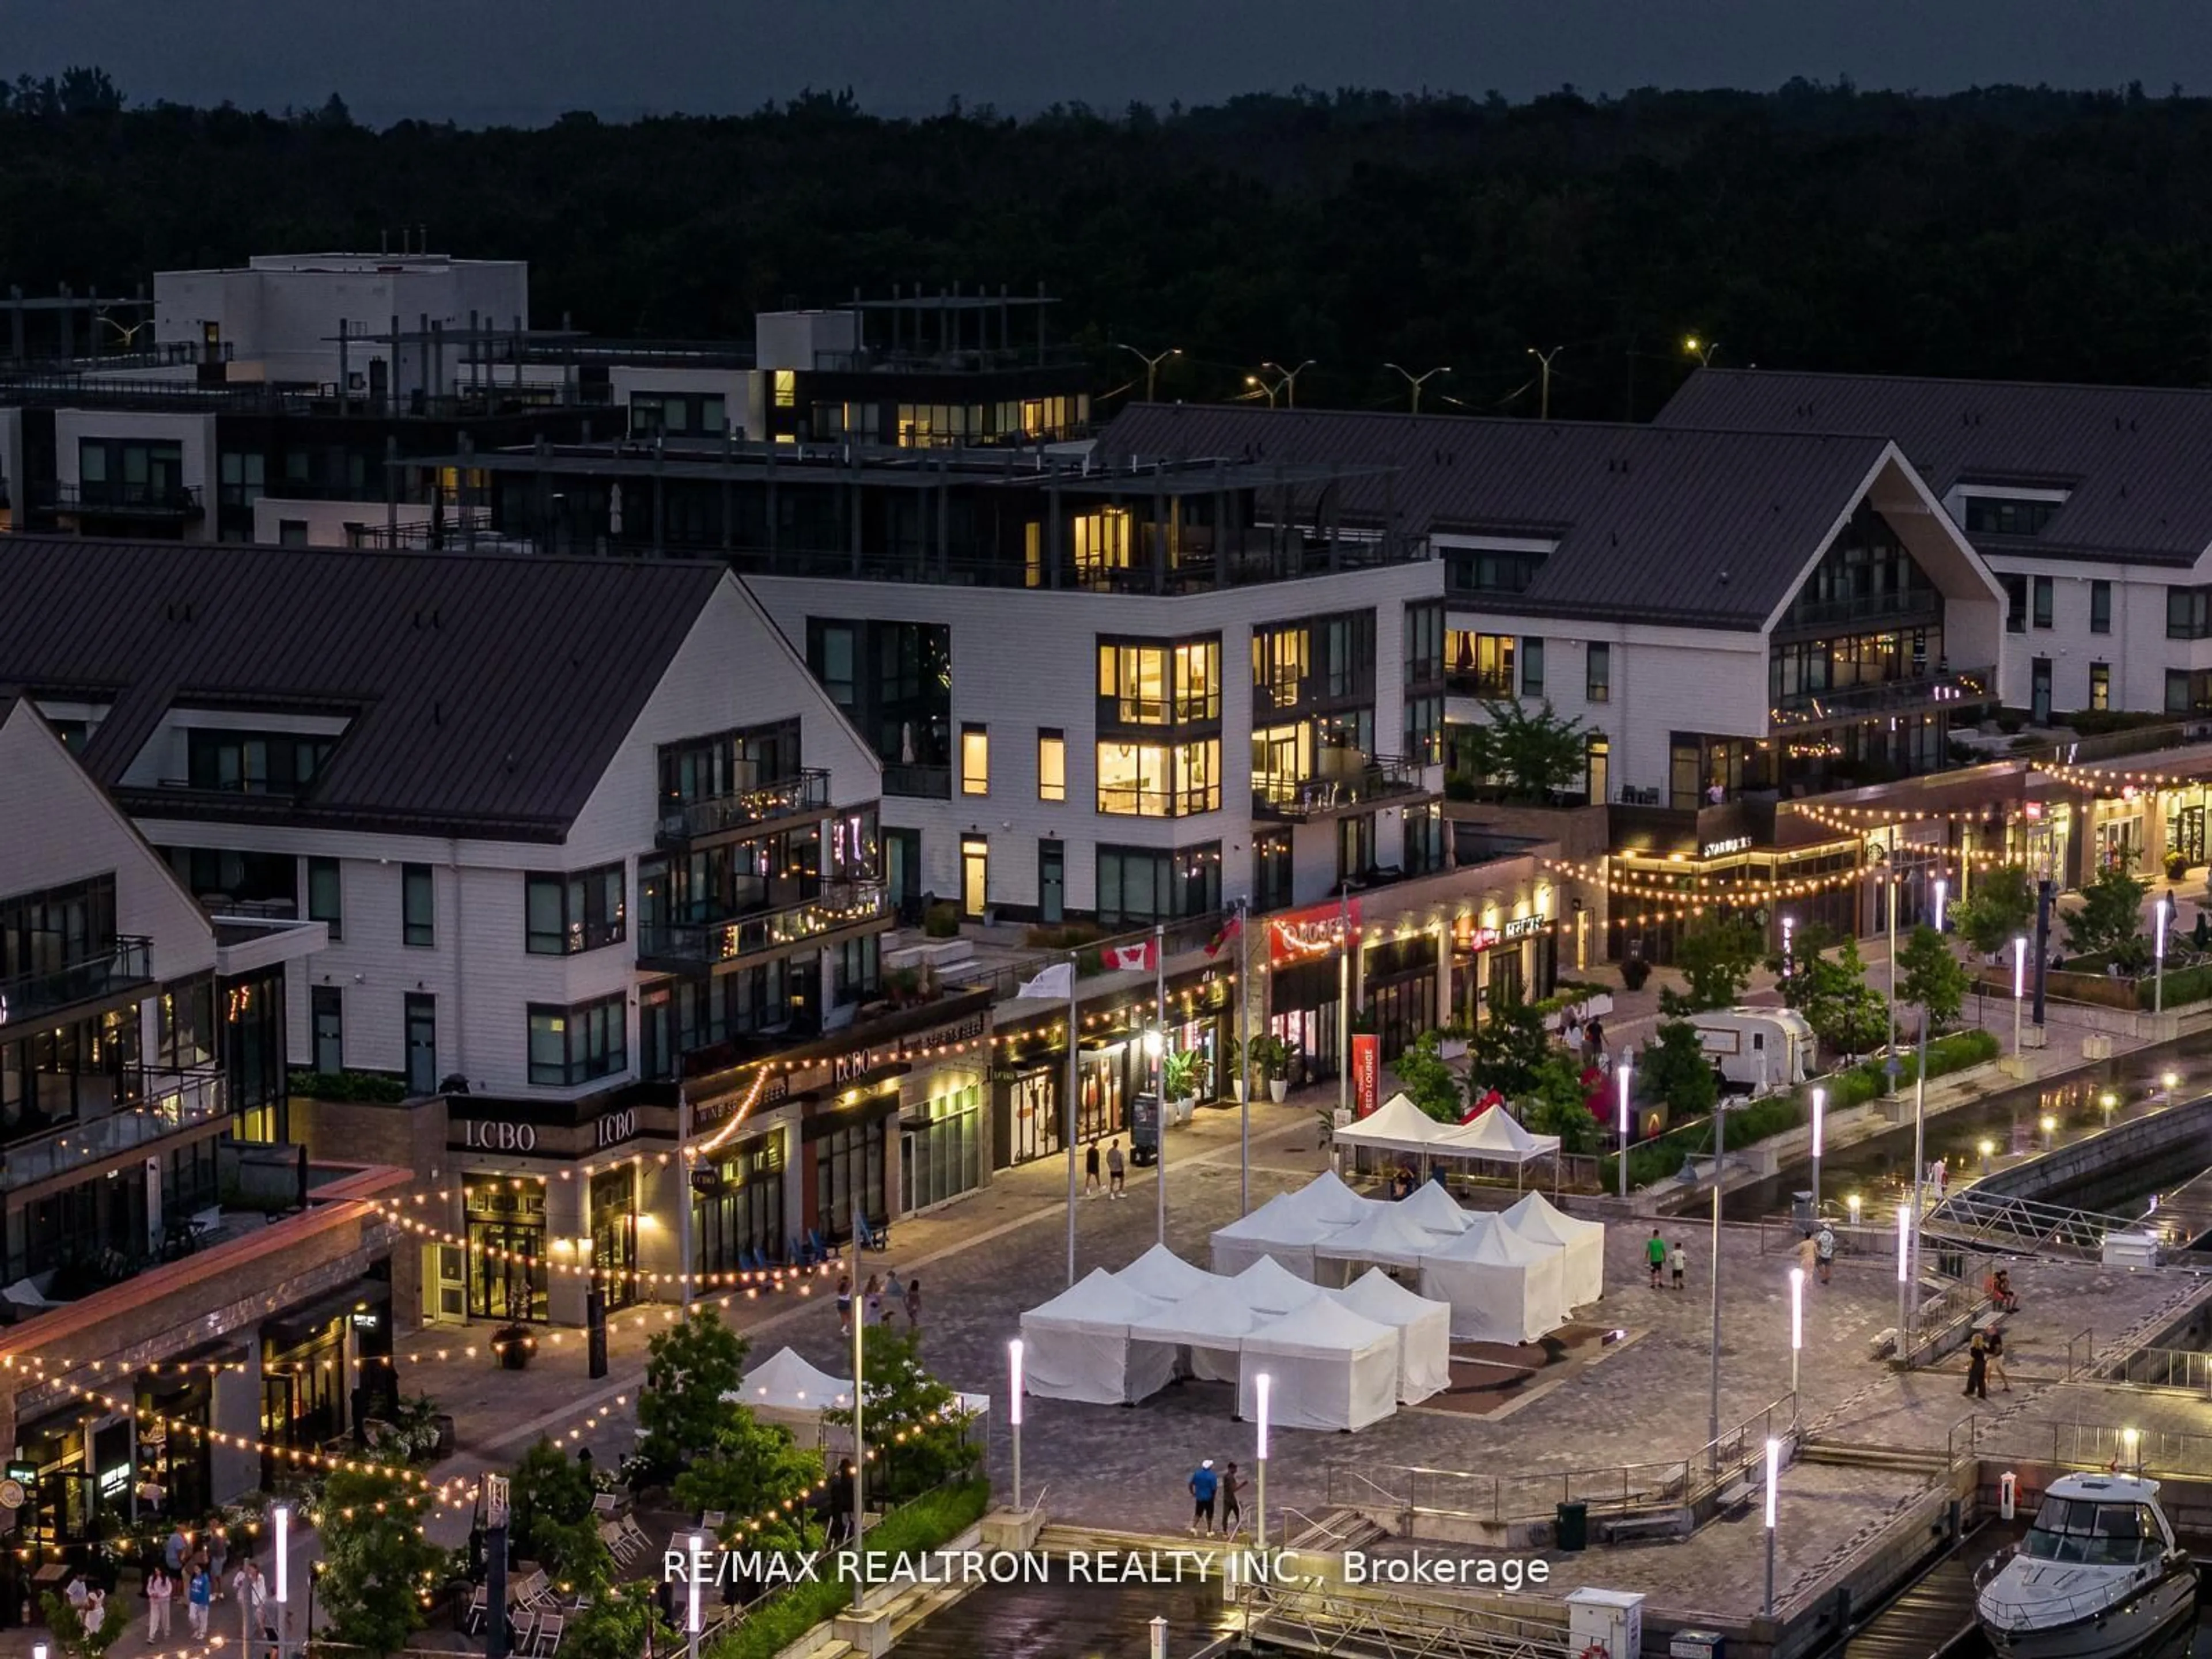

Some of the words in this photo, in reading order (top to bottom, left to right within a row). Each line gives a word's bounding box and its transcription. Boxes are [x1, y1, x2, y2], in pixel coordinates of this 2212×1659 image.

[836, 1048, 871, 1082] LCBO
[1365, 1048, 1373, 1088] LOUNGE
[465, 1120, 536, 1151] LCBO
[600, 1109, 635, 1146] LCBO
